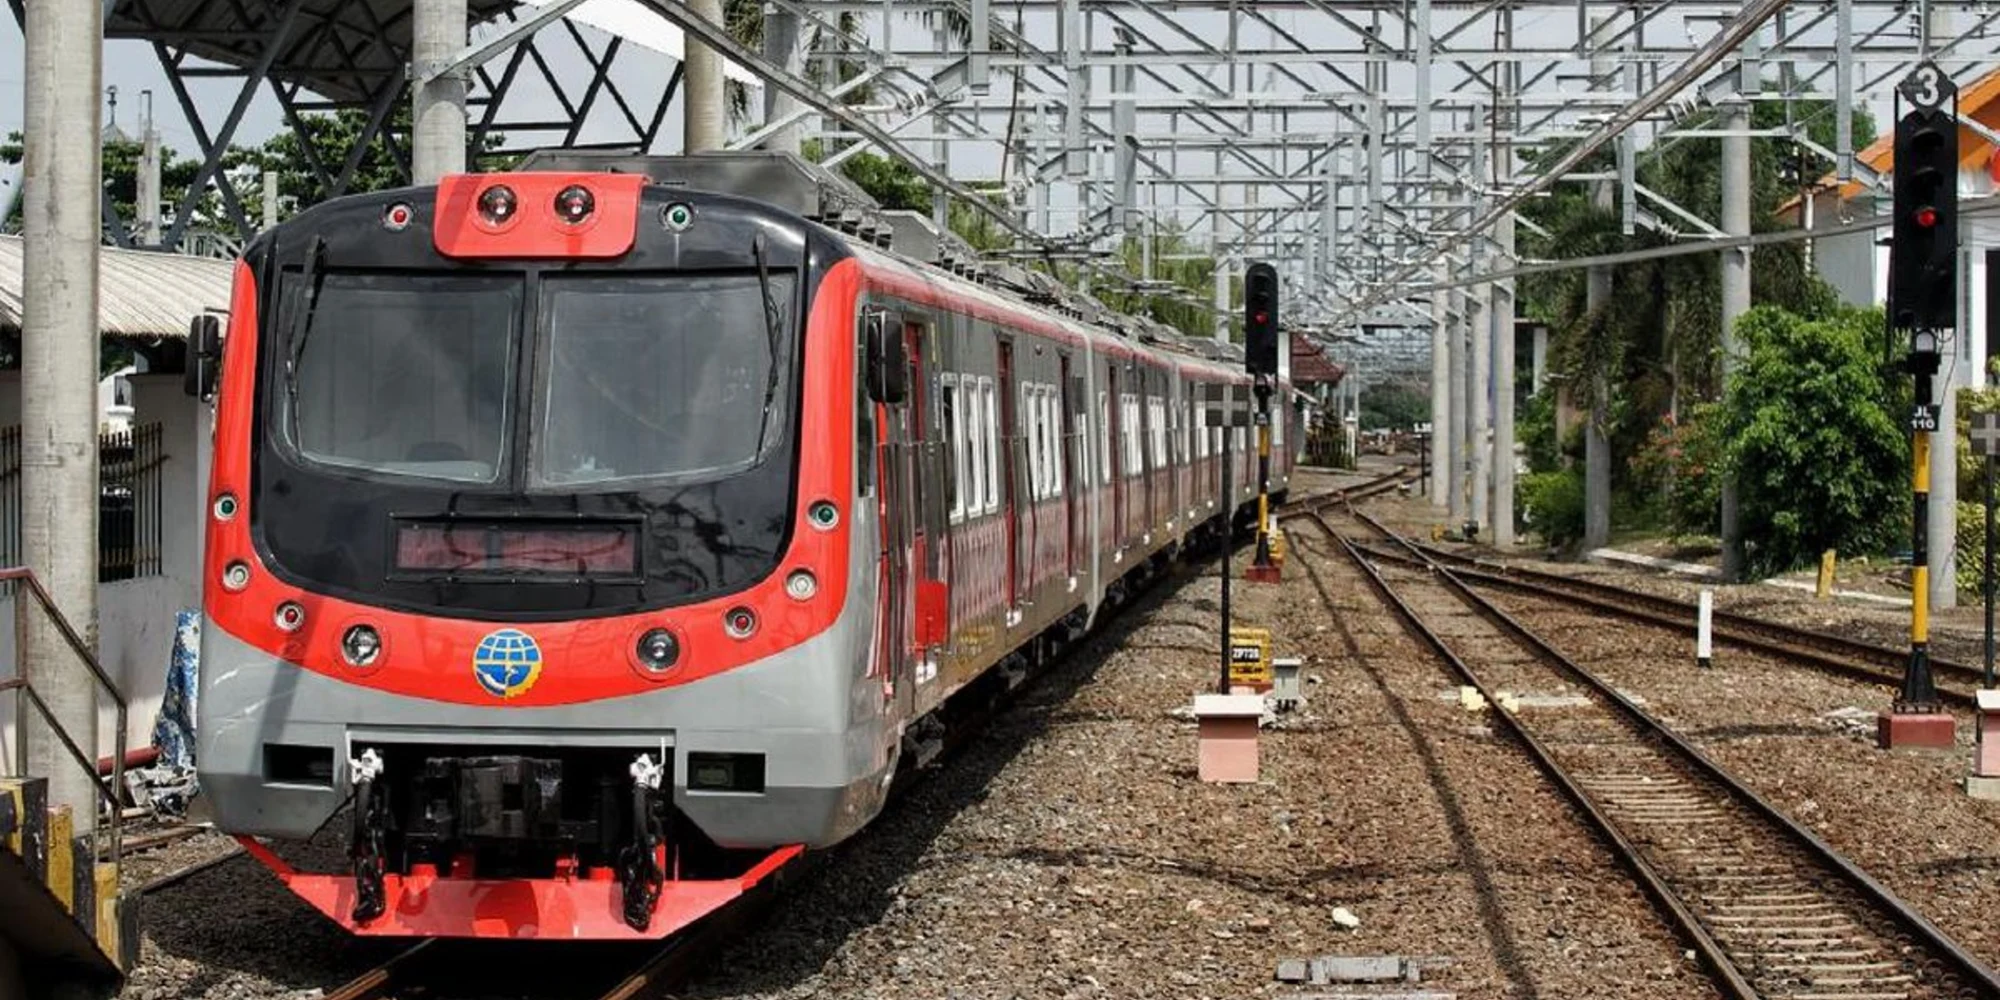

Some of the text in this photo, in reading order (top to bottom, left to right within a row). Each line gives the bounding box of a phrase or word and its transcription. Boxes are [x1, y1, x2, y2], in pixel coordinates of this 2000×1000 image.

[1915, 67, 1939, 106] 3
[1914, 406, 1931, 418] JL
[1911, 419, 1935, 429] 110
